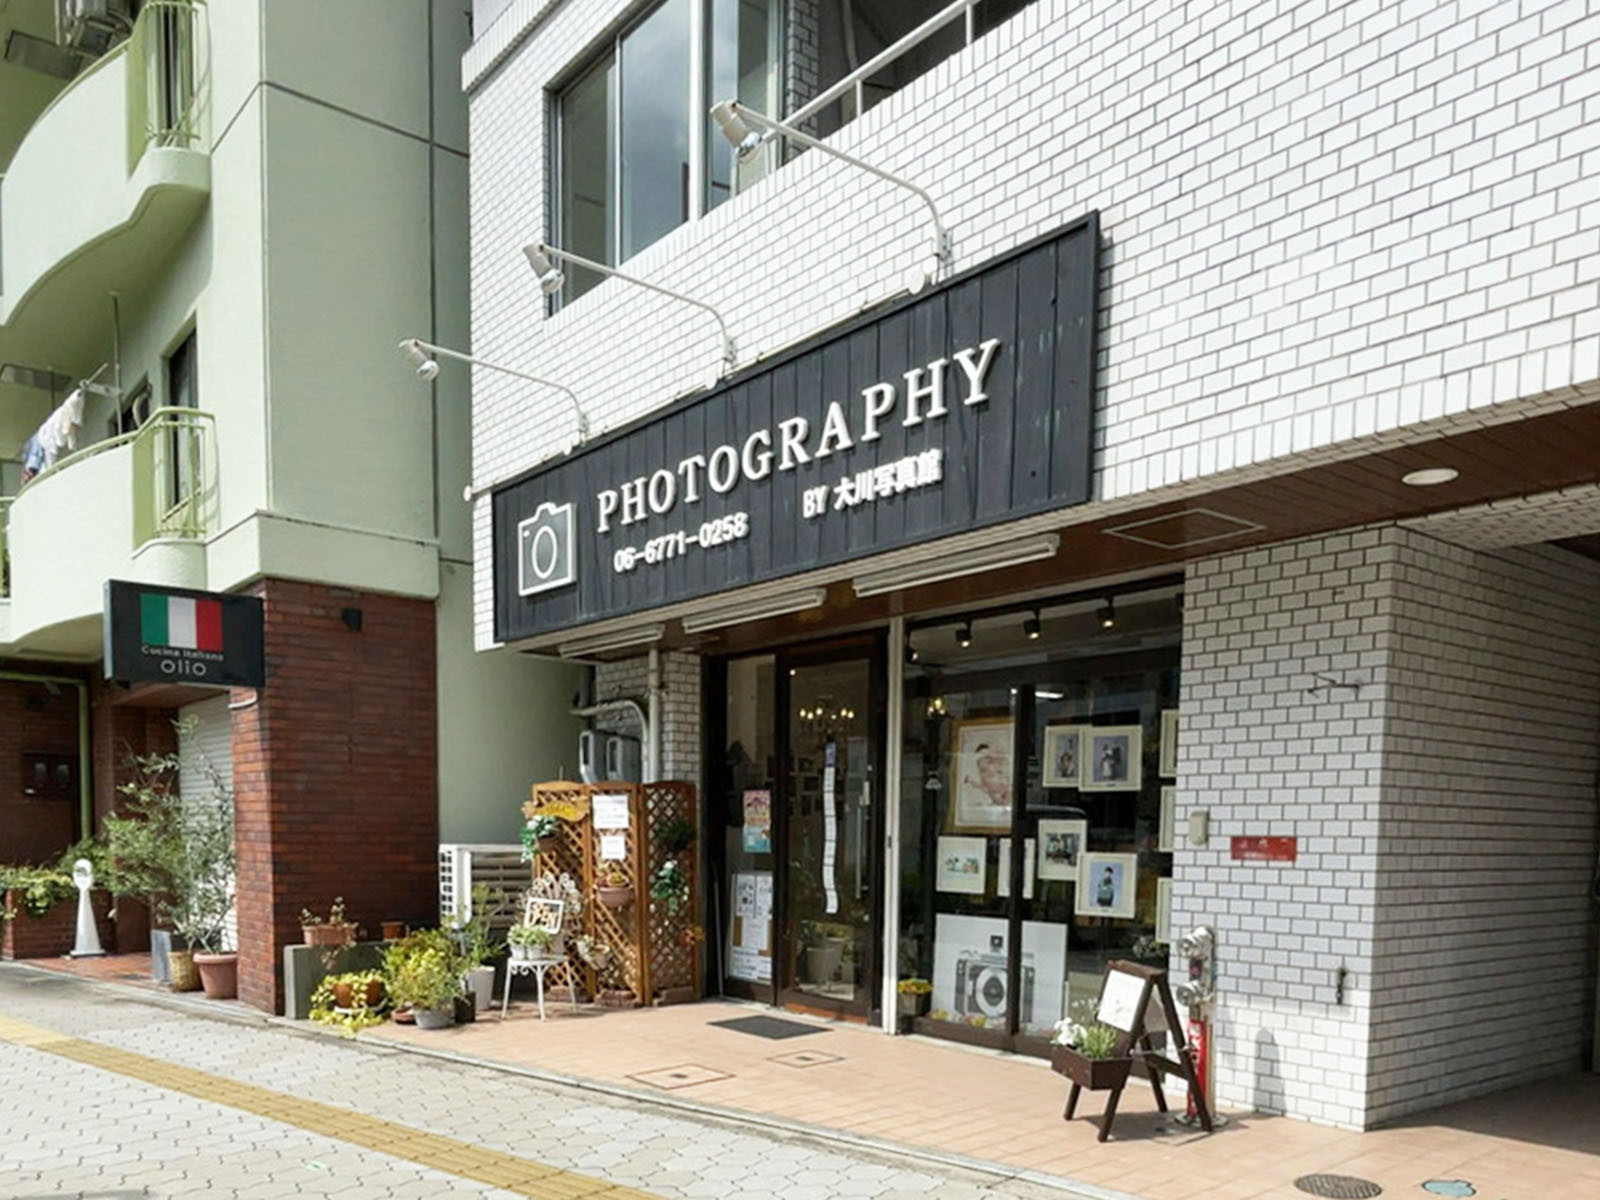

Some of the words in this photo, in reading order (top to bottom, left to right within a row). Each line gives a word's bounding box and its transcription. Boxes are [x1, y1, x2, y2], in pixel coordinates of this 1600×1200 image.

[596, 338, 1000, 533] PHOTOGRAPHY
[802, 485, 829, 519] BY
[833, 448, 943, 511] 大川写真館
[613, 511, 748, 573] 06-6771-0258
